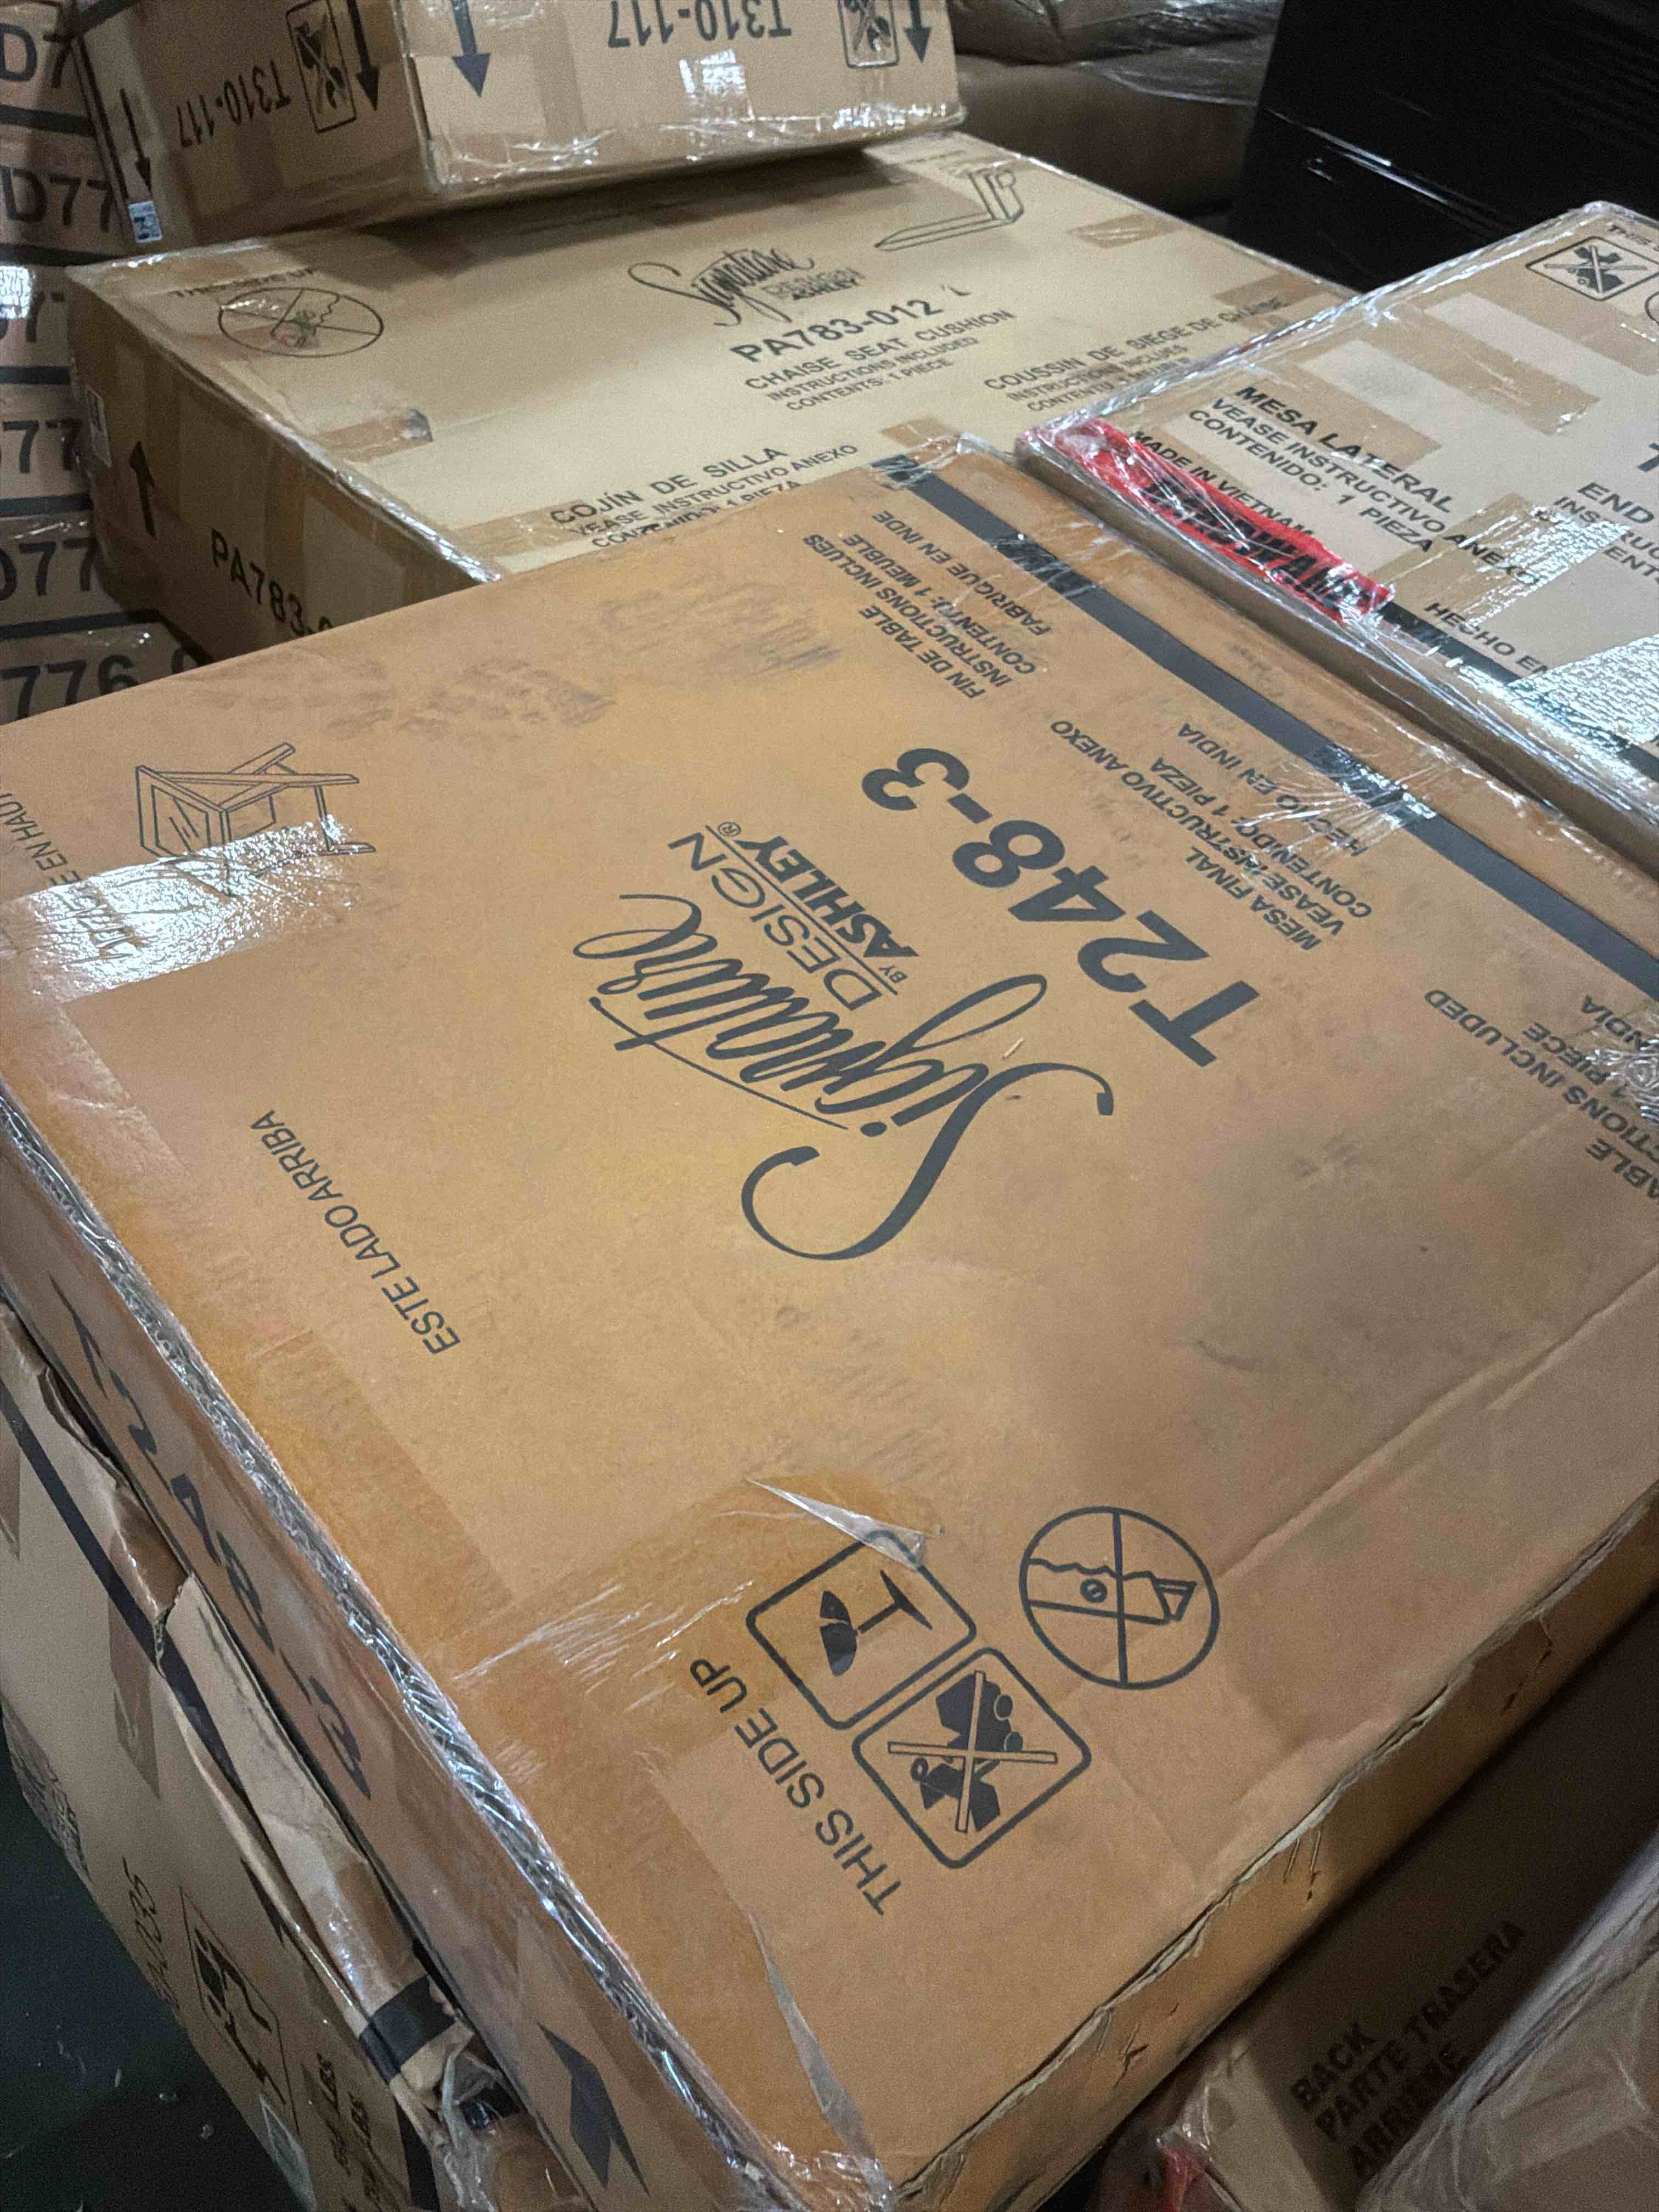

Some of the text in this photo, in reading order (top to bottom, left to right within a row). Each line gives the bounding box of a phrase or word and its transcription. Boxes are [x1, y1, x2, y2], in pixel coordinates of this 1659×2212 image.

[607, 0, 792, 48] T310-117
[176, 60, 291, 148] T310-117
[730, 299, 943, 363] PA783-012
[744, 309, 1016, 391] CHAISE SEAT CUSHION
[768, 336, 980, 402] INSTRUCTIONS INCLUDED
[896, 357, 953, 380] PIECE
[984, 358, 1085, 391] COUSSIN
[1088, 345, 1125, 361] DE
[650, 474, 699, 496] DE
[702, 447, 789, 479] SILLA
[652, 467, 789, 516] INSTRUCTIVO
[788, 443, 859, 474] ANEXO
[1132, 430, 1192, 469] MADE
[1188, 466, 1219, 485] IN
[1188, 409, 1434, 554] CONTENIDO: 1 PIEZA
[1210, 398, 1290, 444] VEASE
[1287, 441, 1446, 535] INSTRUCTIVO
[1235, 385, 1454, 514] MESA LATERAL
[1577, 482, 1655, 523] END
[843, 534, 922, 588] MEUBLE
[872, 510, 1052, 635] FABRIQUE EN INDE
[914, 586, 933, 596] 1
[859, 605, 986, 698] FIN DE TABLE
[876, 587, 1013, 687] INSTRUCTIONS
[1425, 602, 1517, 657] HECHO
[1150, 757, 1217, 808] PIEZA
[1177, 723, 1243, 771] INDIA
[1238, 767, 1280, 795] EN
[0, 793, 69, 871] EN HAU
[1050, 720, 1345, 935] VEASE INSTRUCTIVO ANEXO
[1211, 804, 1229, 816] 1
[667, 830, 884, 1012] DESIGN
[734, 834, 920, 984] BY ASHLEY
[861, 747, 1261, 1068] T248-3
[1185, 846, 1323, 951] MESA FINAL
[1522, 1022, 1611, 1086] PIECE
[1580, 994, 1659, 1051] NDIA
[571, 893, 1115, 1261] Signature
[1424, 989, 1659, 1164] CTIONS INCLUDED
[1585, 1138, 1659, 1199] ABLE
[250, 1110, 461, 1355] ESTE LADO ARRIBA
[49, 1273, 372, 1800] T248-3
[689, 1658, 902, 1916] THIS SIDE UP
[1290, 2022, 1376, 2112] BACK
[1314, 1920, 1528, 2142] PARTE TRASERA
